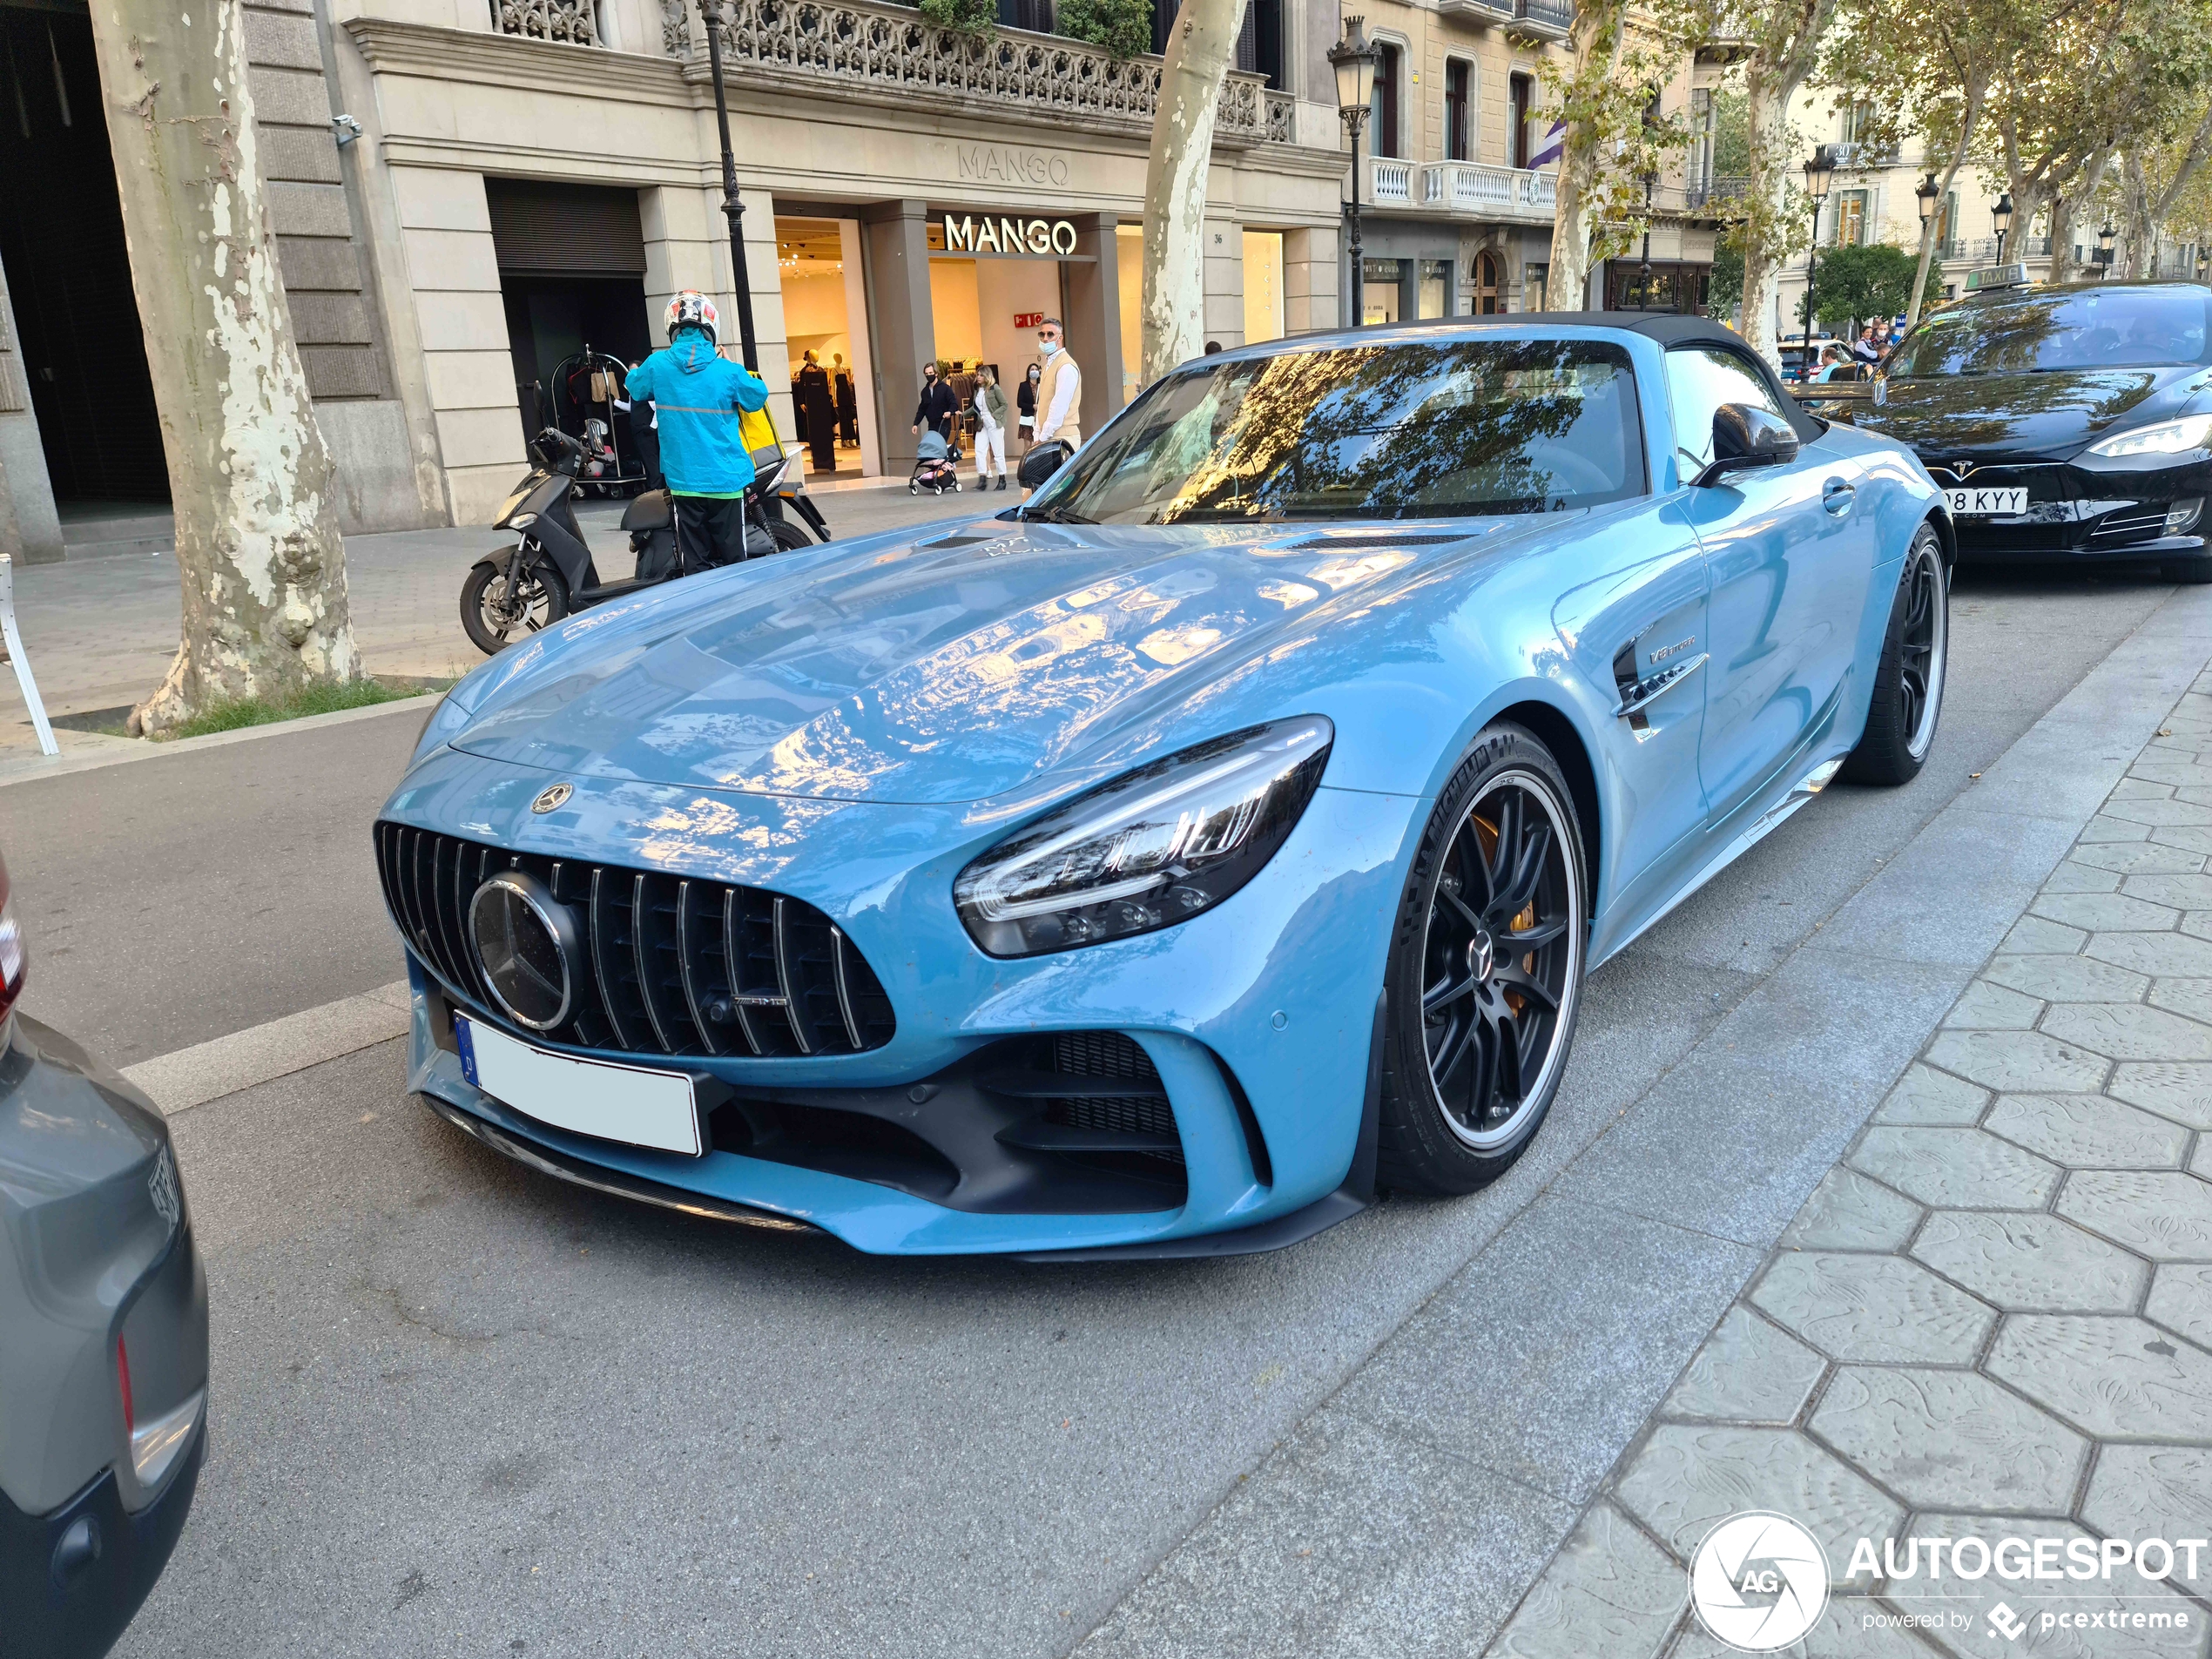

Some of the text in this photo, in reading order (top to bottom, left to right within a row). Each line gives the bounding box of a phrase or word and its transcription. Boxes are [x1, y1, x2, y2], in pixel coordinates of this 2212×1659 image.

[957, 145, 1069, 186] MANGO
[944, 214, 1077, 255] MANGO
[1214, 233, 1223, 244] 36
[1980, 268, 2006, 284] TAXI
[1975, 491, 2021, 510] KYY
[1649, 635, 1696, 664] V8 BITURBO
[1426, 745, 1490, 846] MICHELIN
